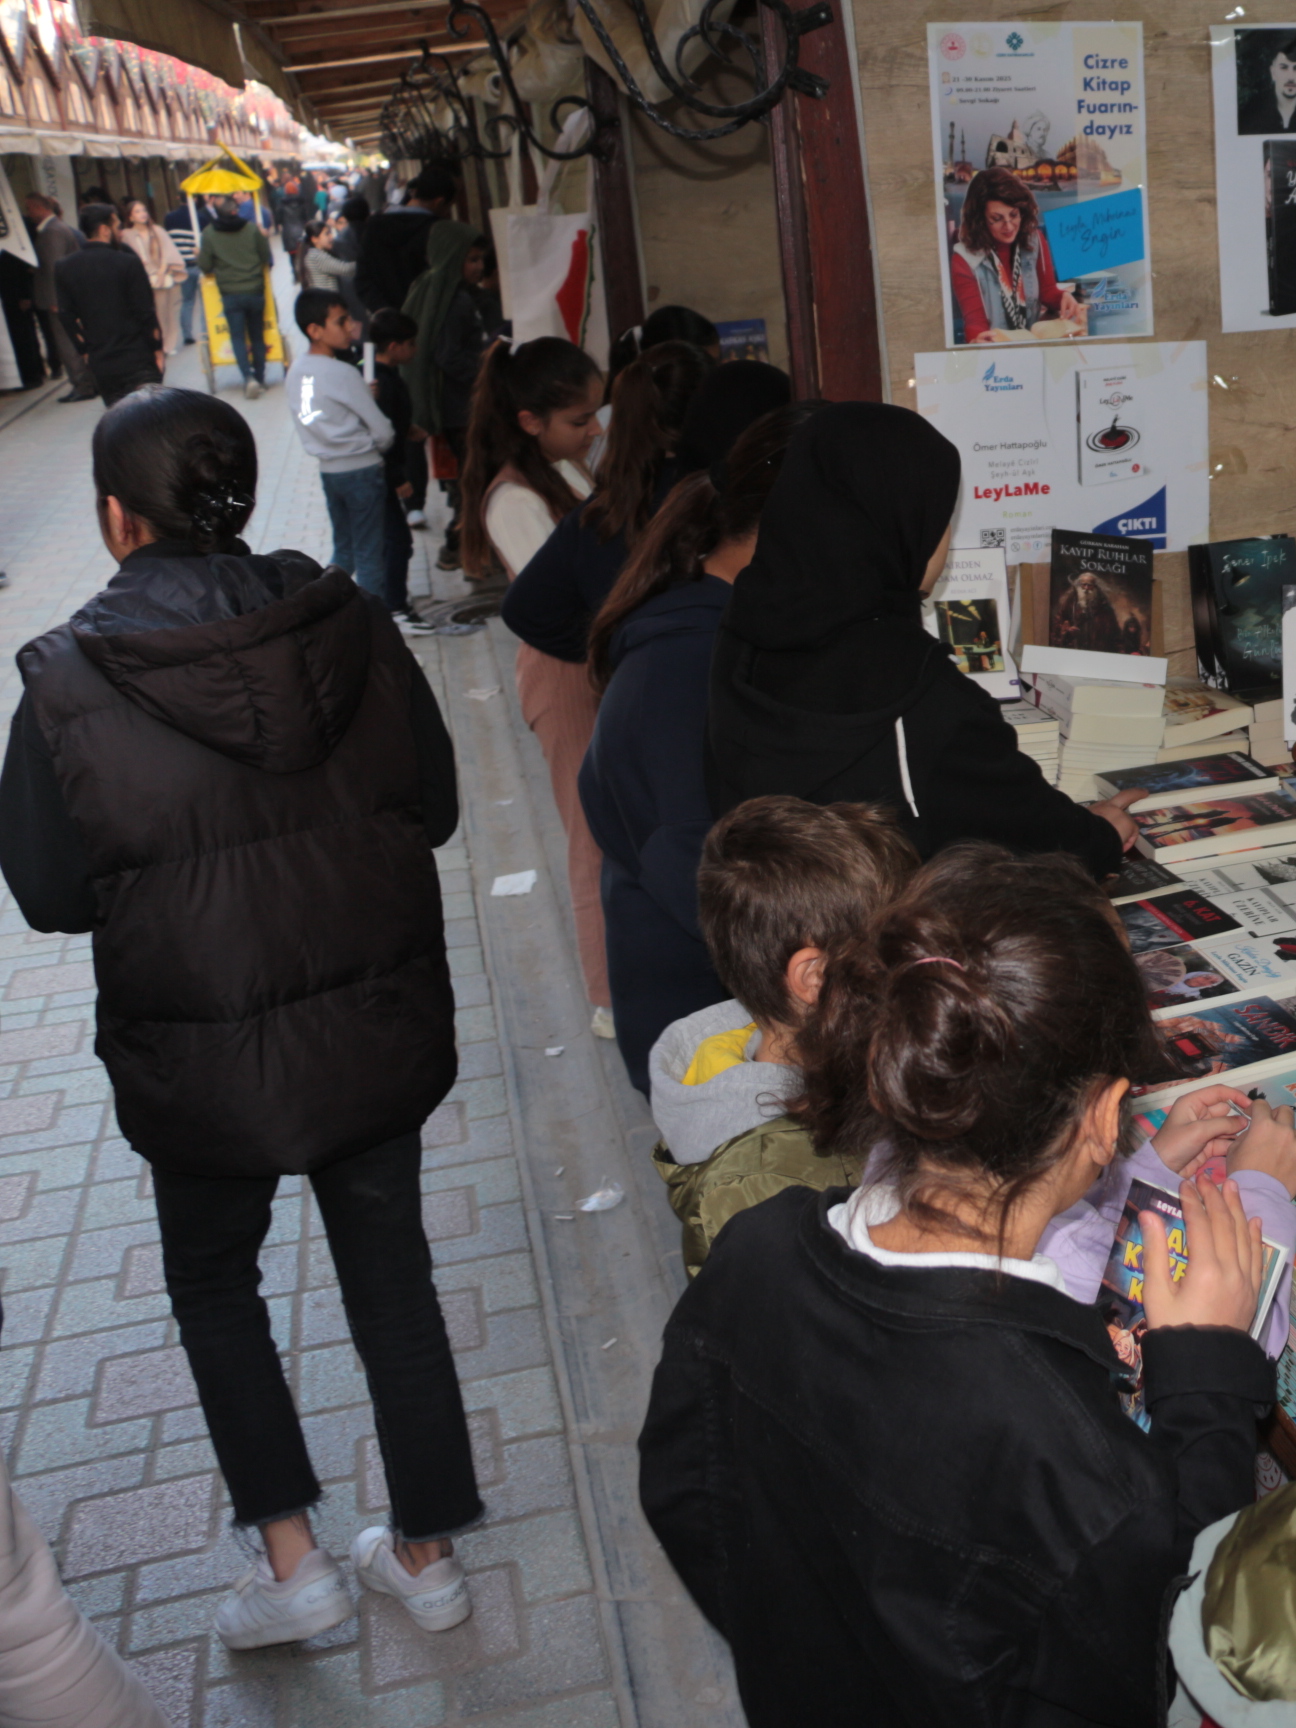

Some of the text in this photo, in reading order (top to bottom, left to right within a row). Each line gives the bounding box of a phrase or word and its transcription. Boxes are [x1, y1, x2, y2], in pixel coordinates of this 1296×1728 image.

[1083, 54, 1129, 70] Cizre
[1083, 77, 1131, 96] Kitap
[1076, 99, 1139, 114] Fuarın-
[1083, 120, 1133, 139] dayız
[1104, 290, 1128, 301] Erda
[1093, 301, 1139, 312] Yayınları
[984, 383, 1023, 393] Yayınları
[973, 440, 1048, 452] Ömer Hattapoğlu
[973, 481, 1051, 501] LeyLaMe
[1002, 510, 1033, 519] Roman
[1117, 517, 1157, 534] ÇIKTI
[1060, 545, 1147, 565] KAYIP RUHLAR
[1080, 559, 1126, 575] SOKAĞI
[961, 571, 994, 582] OLMAZ
[1227, 952, 1259, 978] GAZİN
